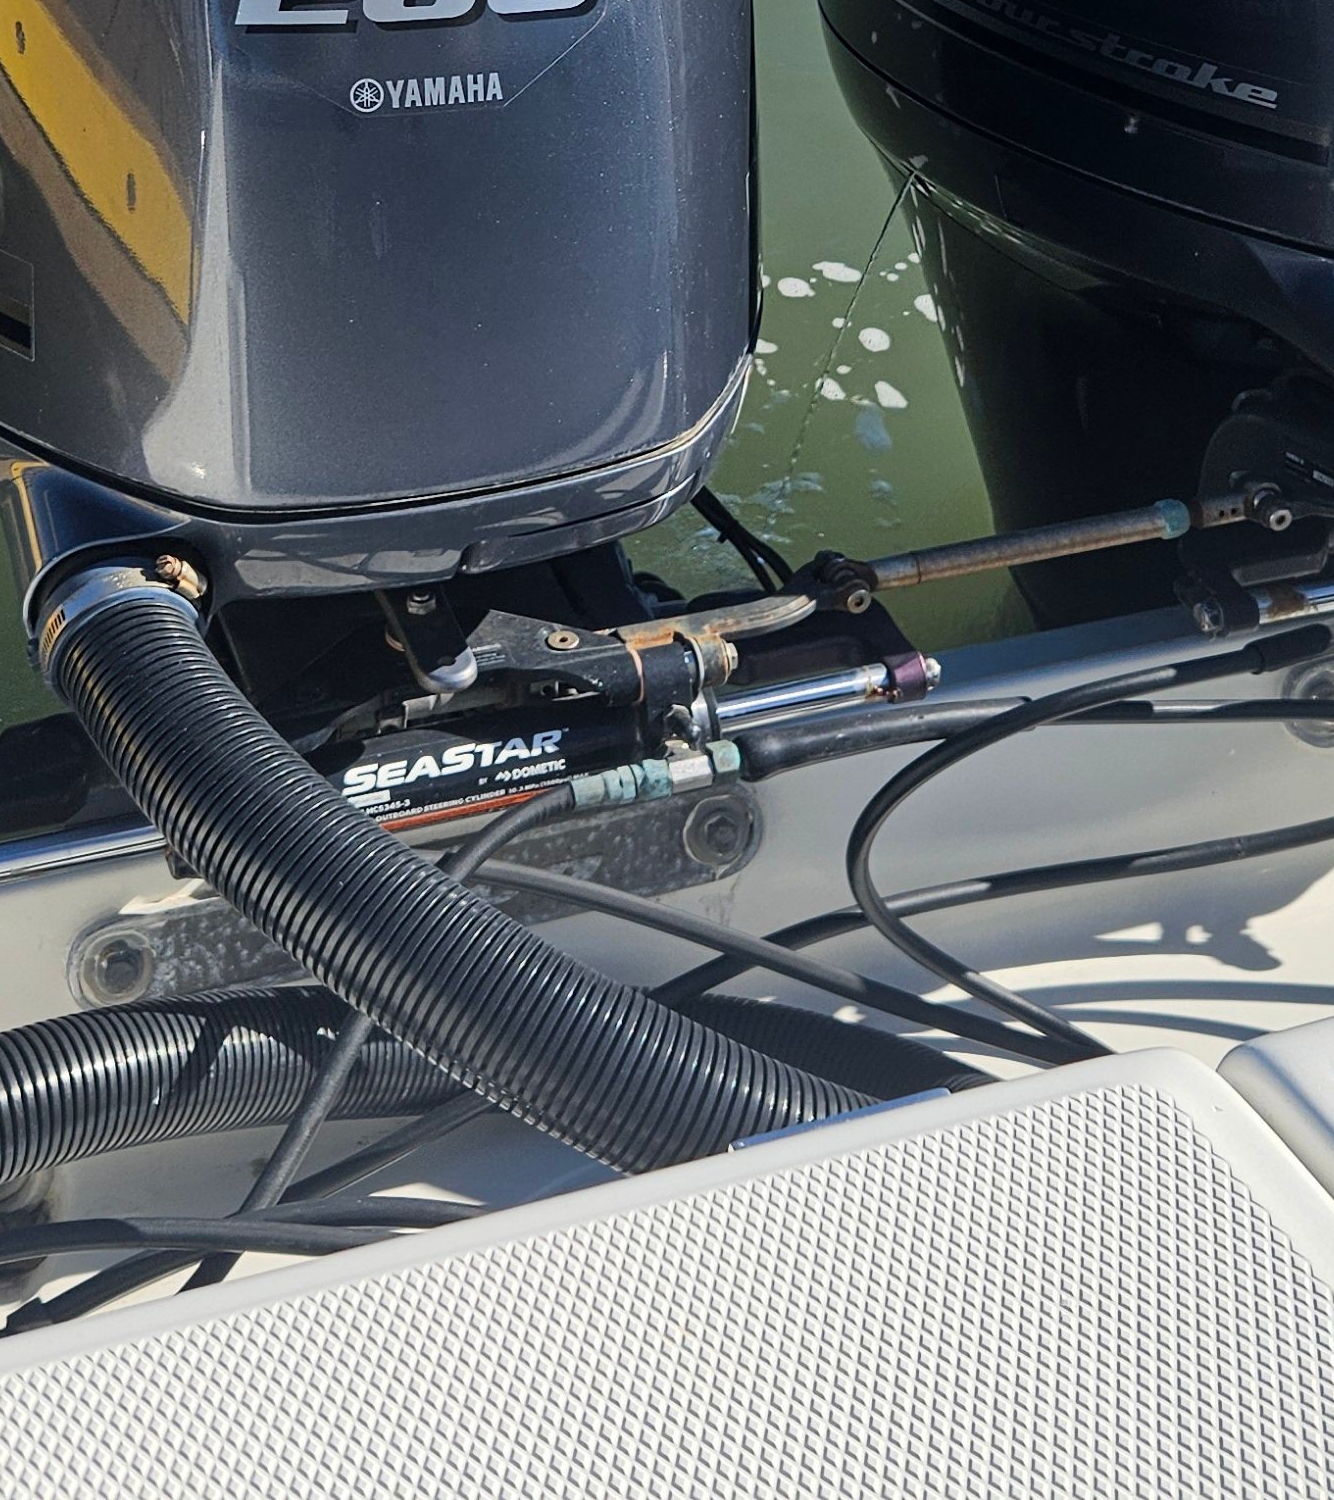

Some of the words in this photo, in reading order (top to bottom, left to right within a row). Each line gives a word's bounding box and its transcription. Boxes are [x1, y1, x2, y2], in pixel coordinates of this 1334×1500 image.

[386, 72, 504, 109] YAMAHA
[342, 728, 564, 797] SEASTAR
[511, 758, 567, 781] DOMETIC
[375, 806, 424, 823] OUTBOARD
[424, 797, 465, 812] STEERING
[465, 788, 506, 804] CYLINDER
